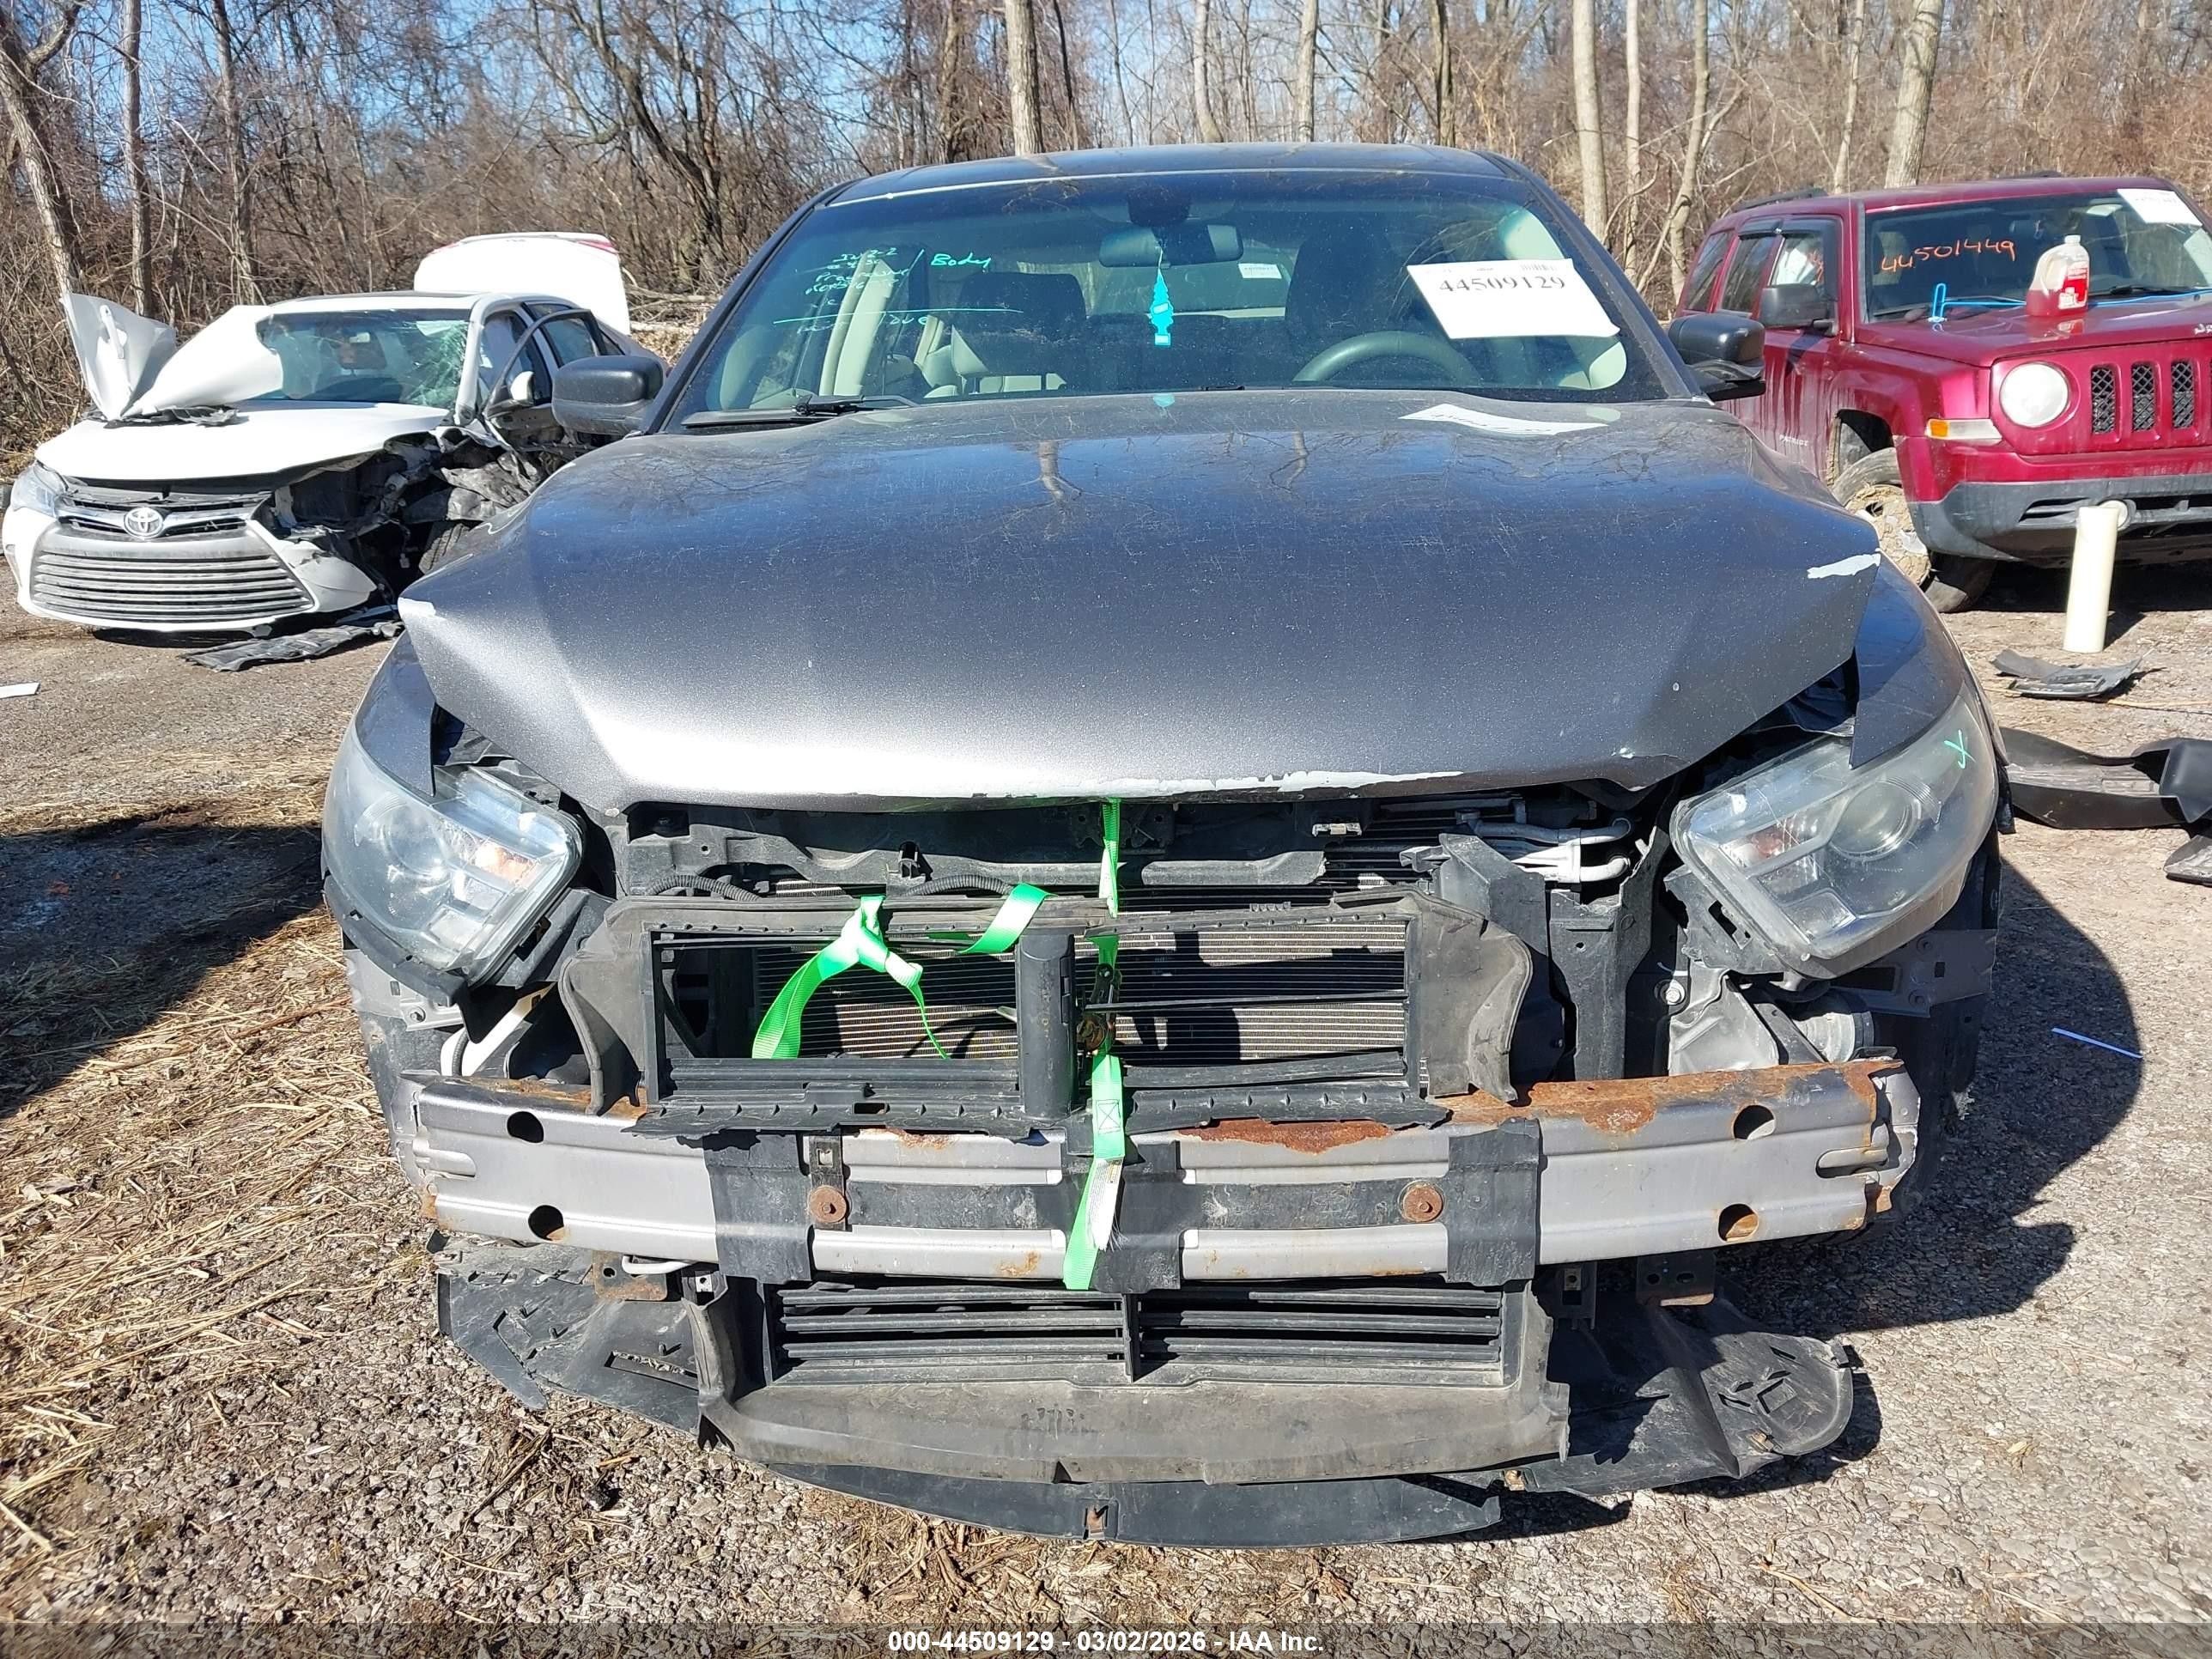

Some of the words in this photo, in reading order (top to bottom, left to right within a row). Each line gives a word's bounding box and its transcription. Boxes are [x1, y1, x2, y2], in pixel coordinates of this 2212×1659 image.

[930, 251, 992, 270] Body
[1881, 238, 2016, 273] 44501449
[1438, 275, 1566, 292] 44509129
